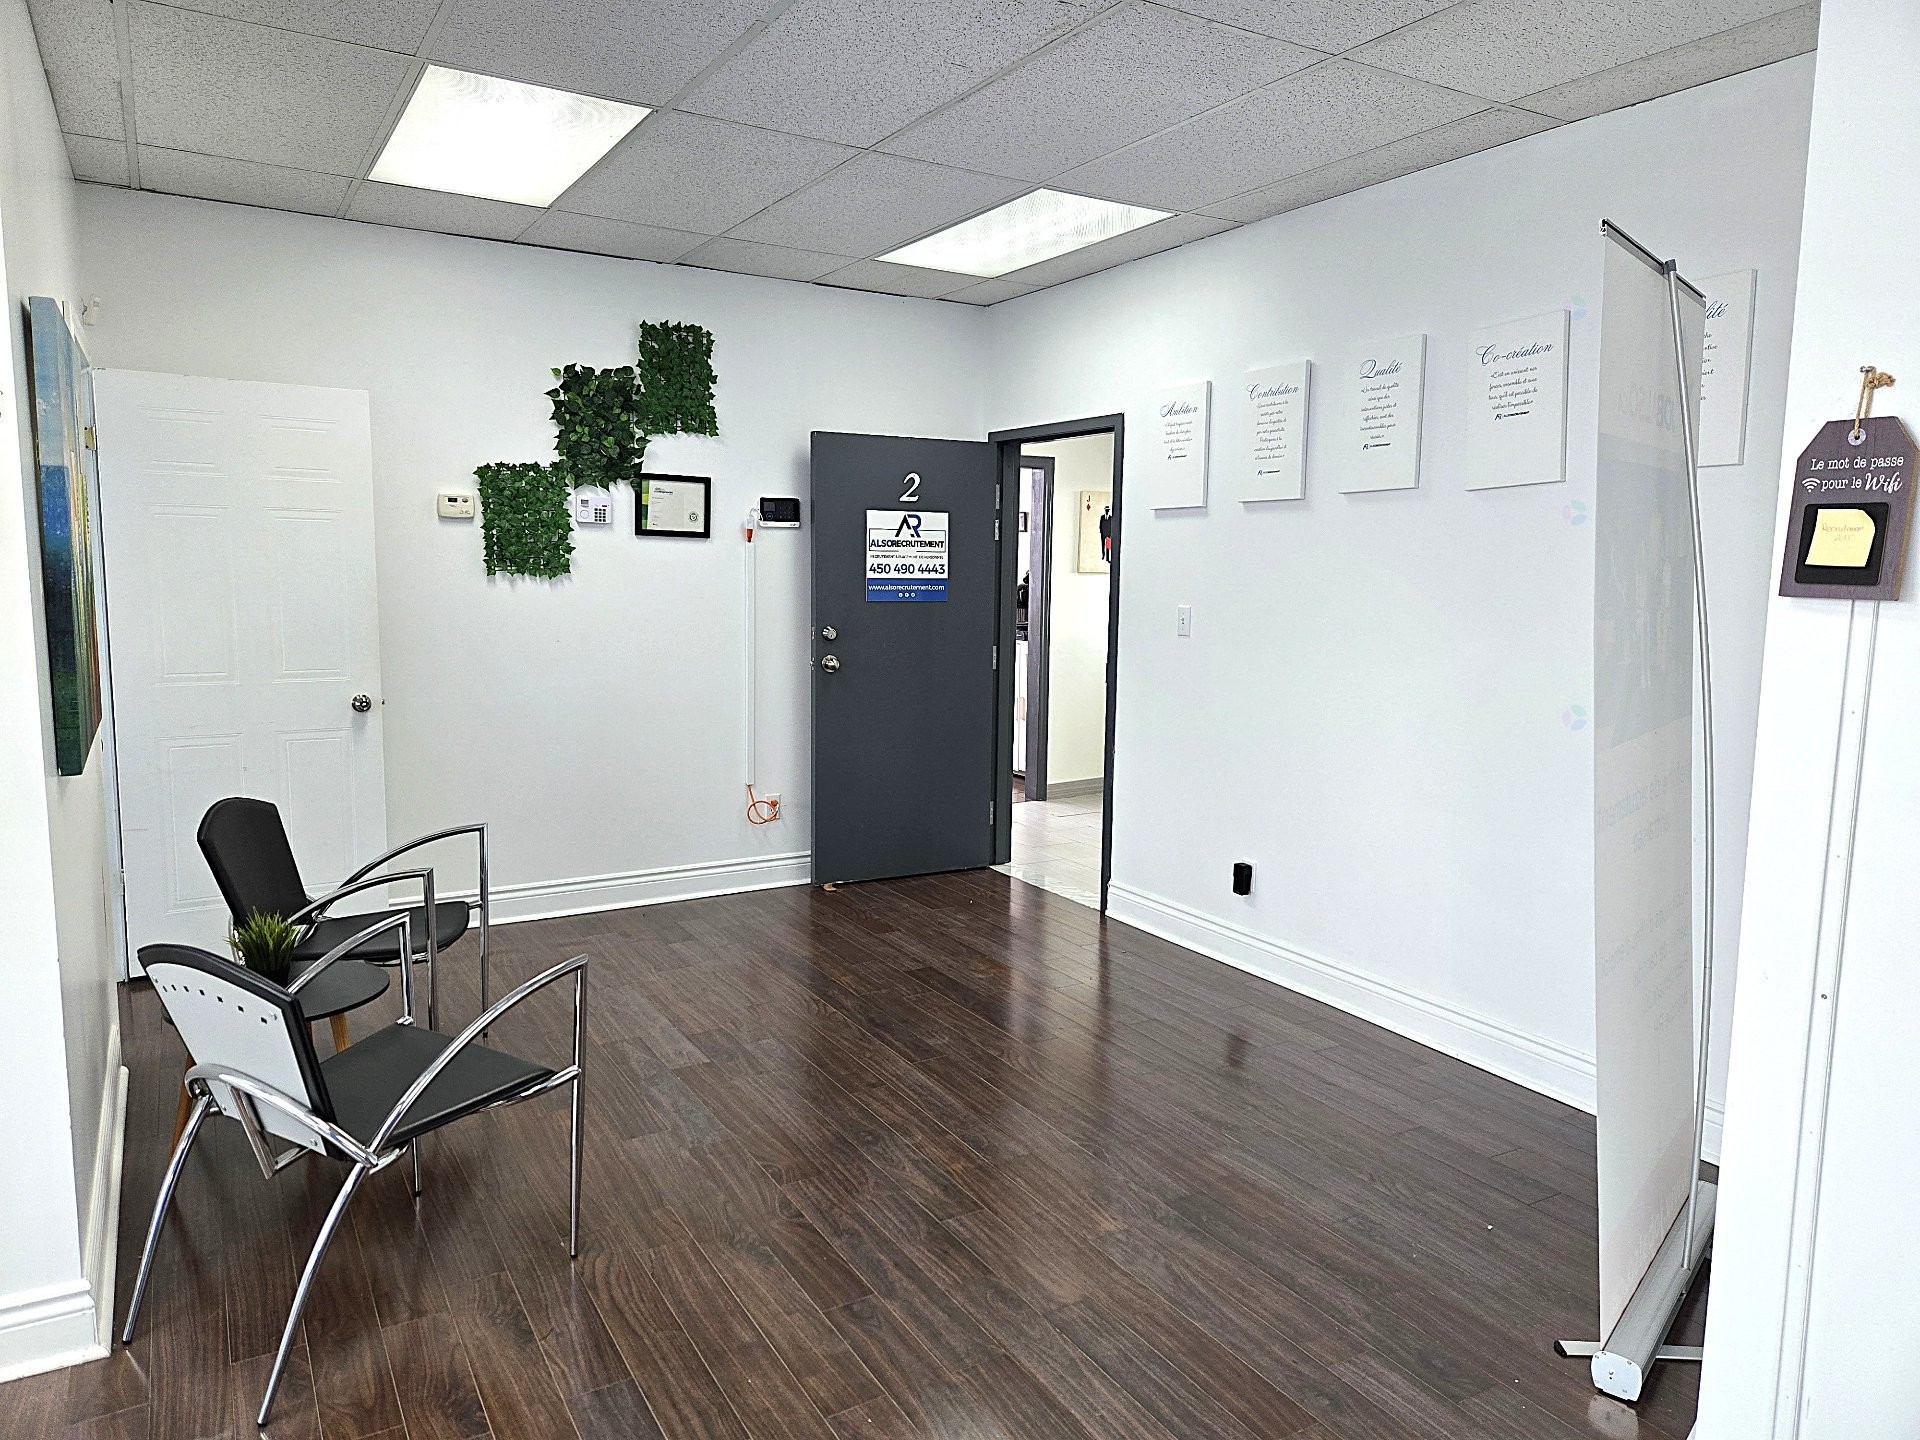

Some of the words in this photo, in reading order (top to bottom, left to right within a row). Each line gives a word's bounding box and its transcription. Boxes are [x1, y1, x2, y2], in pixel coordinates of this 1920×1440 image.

[1475, 342, 1554, 367] Co-création
[1360, 359, 1403, 379] Qualité
[1246, 383, 1299, 401] Contribution
[1160, 401, 1198, 417] Ambition
[1810, 458, 1825, 471] Le
[1827, 456, 1850, 470] mot
[1853, 456, 1866, 468] de
[1870, 456, 1904, 470] passe
[899, 472, 921, 502] 2
[1820, 479, 1849, 492] pour
[1850, 476, 1862, 489] le
[1865, 472, 1903, 494] Wifi
[1086, 494, 1091, 502] J
[870, 539, 945, 549] ALSORECRUTEMENT
[869, 563, 891, 574] 450
[893, 563, 915, 574] 490
[917, 564, 946, 575] 4443
